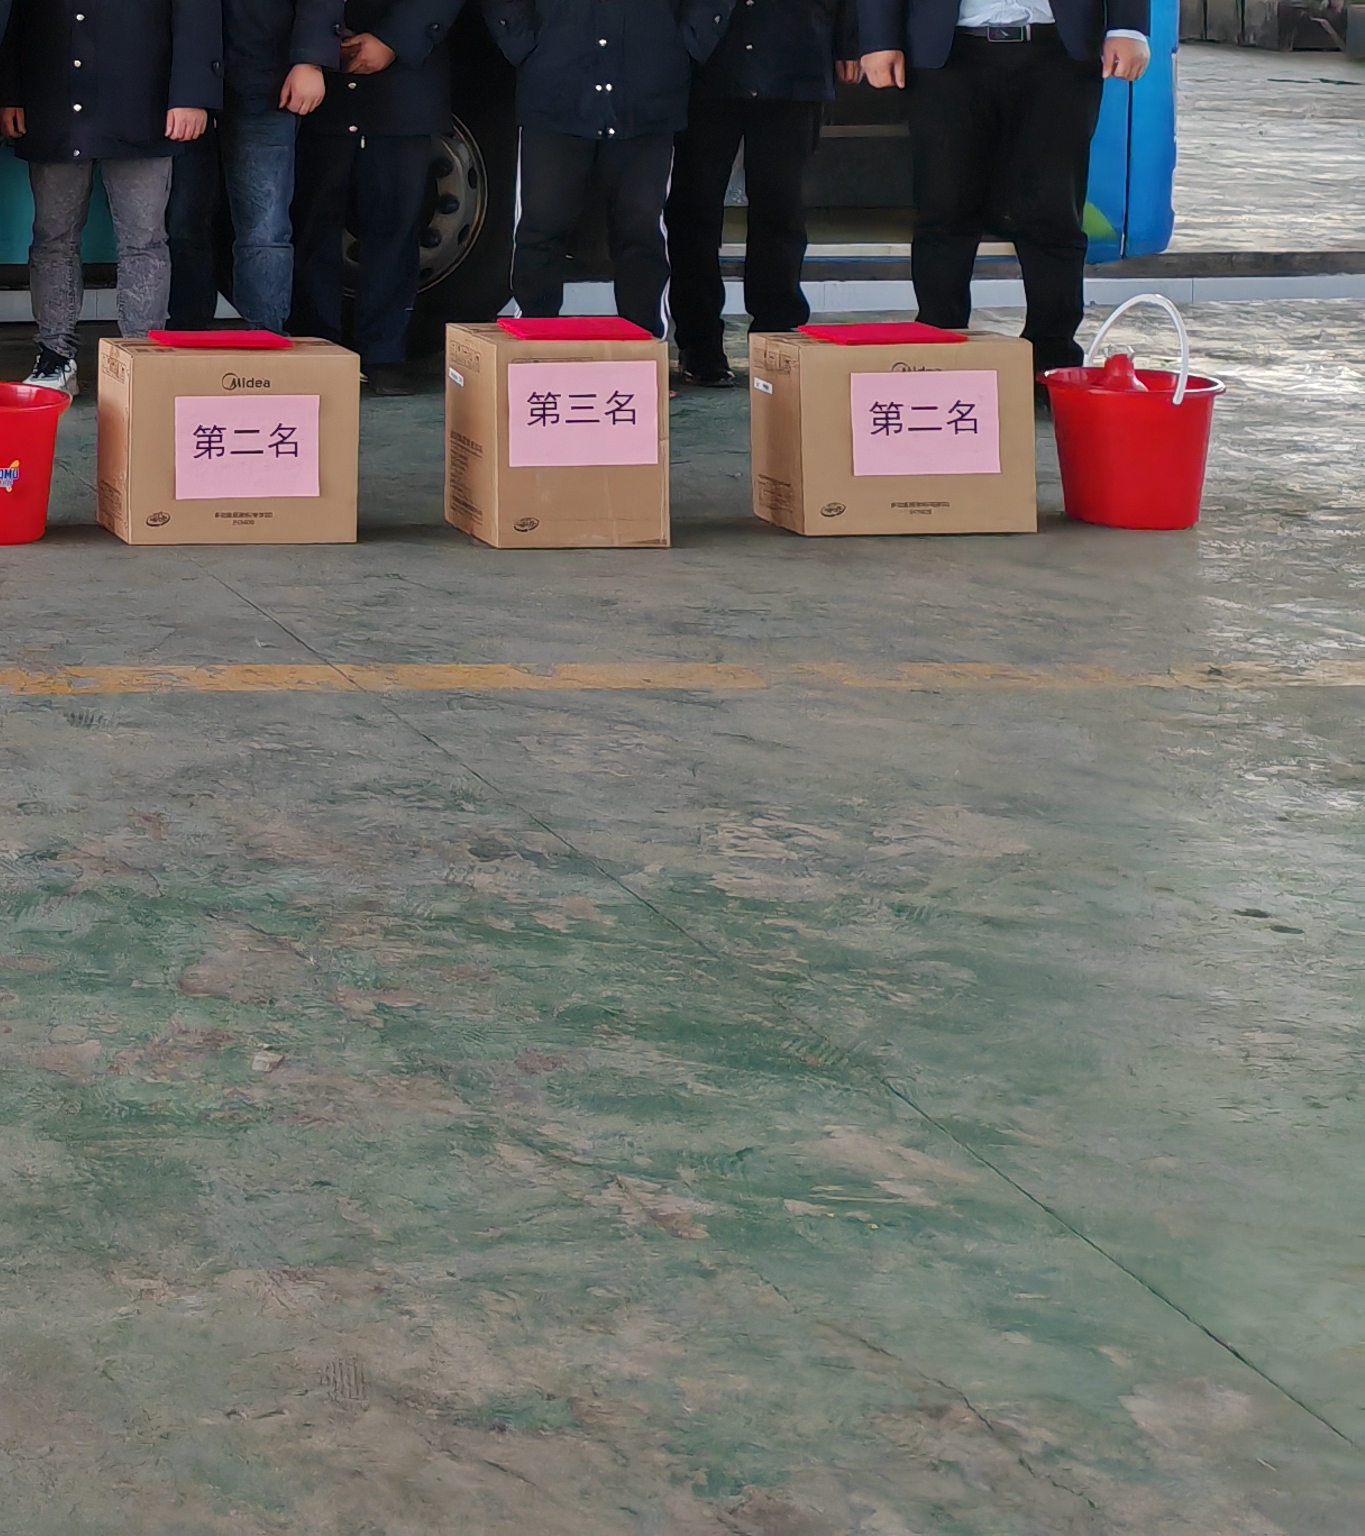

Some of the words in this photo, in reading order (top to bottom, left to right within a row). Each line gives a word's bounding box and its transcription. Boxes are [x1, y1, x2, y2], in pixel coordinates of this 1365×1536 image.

[222, 372, 271, 391] Midea
[526, 390, 636, 427] 第三名
[868, 399, 979, 437] 第二名
[192, 422, 299, 460] 第二名
